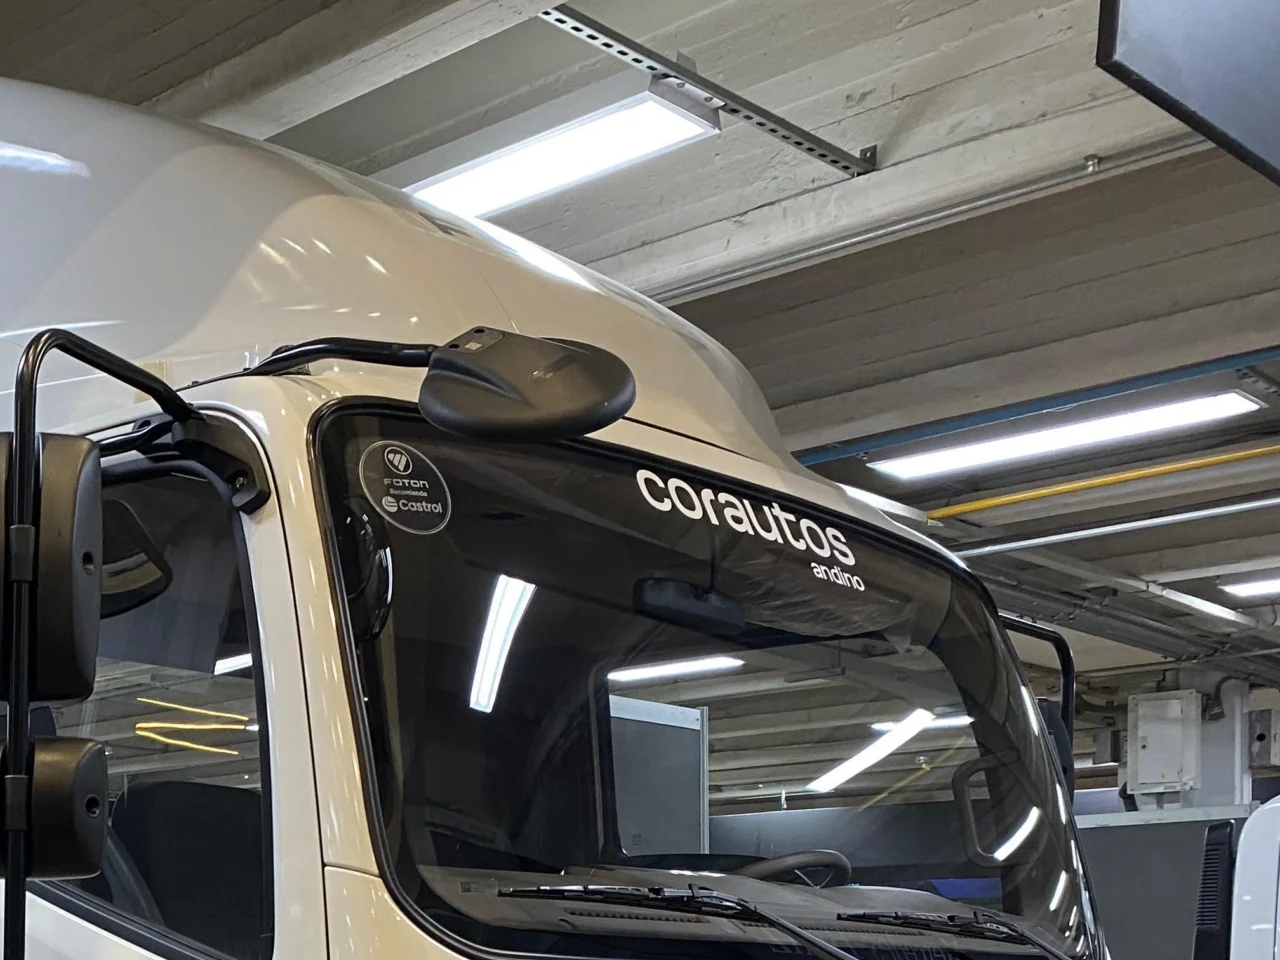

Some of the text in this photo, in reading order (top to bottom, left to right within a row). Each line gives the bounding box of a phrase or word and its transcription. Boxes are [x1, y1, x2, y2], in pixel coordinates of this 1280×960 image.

[384, 478, 429, 489] FOTON
[400, 499, 443, 513] Castrol
[636, 469, 856, 566] corautos
[811, 562, 866, 592] andino
